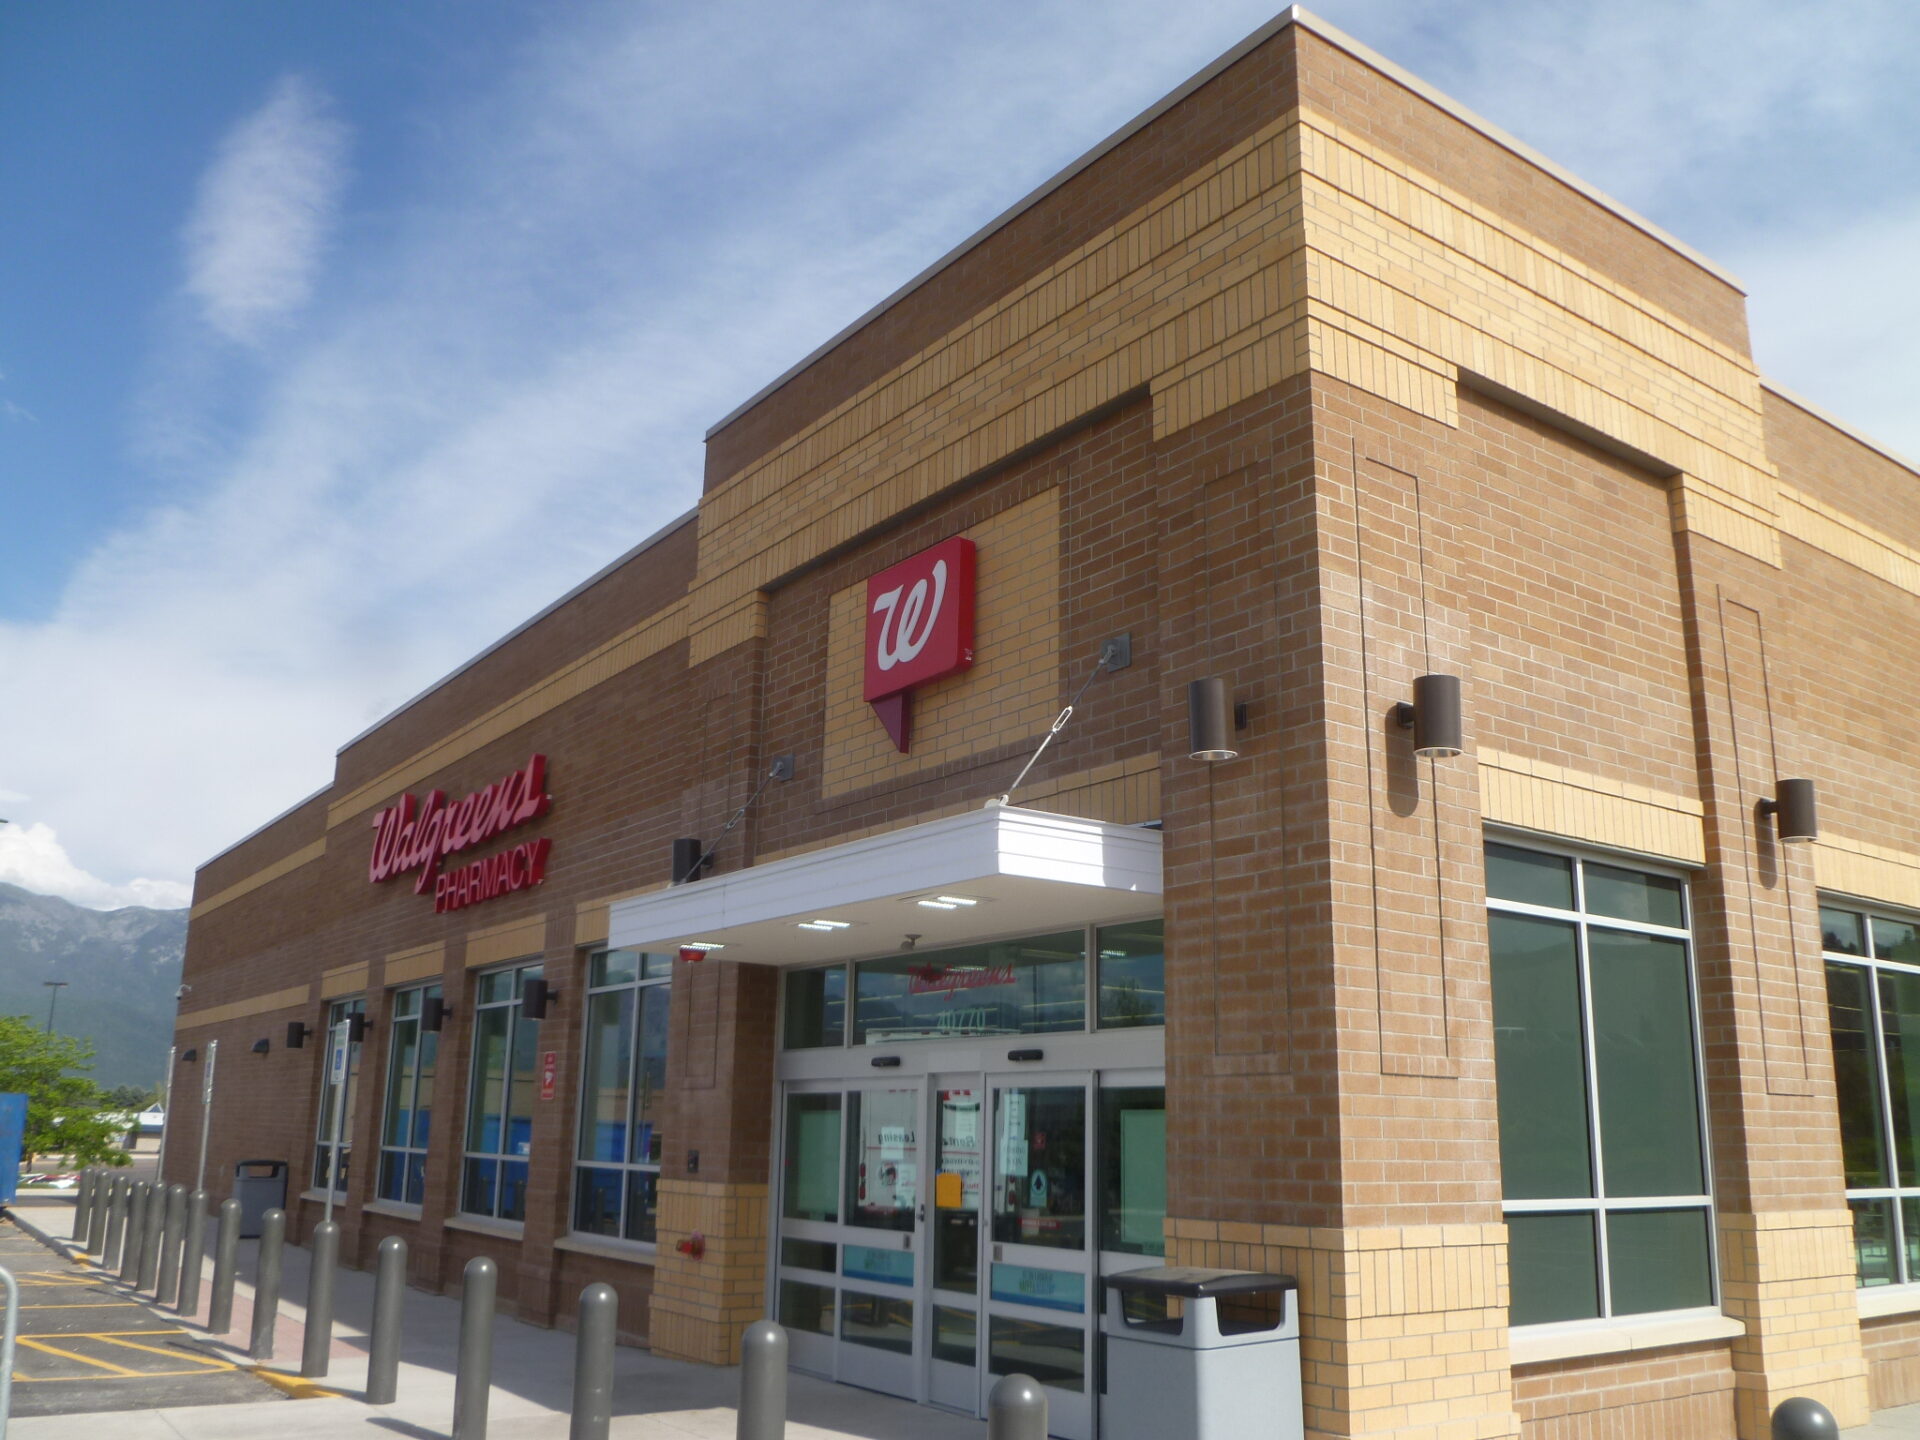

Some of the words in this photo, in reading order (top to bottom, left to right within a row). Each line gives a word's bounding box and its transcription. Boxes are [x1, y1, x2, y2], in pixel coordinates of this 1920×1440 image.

[873, 559, 948, 671] W
[369, 753, 550, 894] Walgreens
[434, 838, 551, 913] PHARMACY
